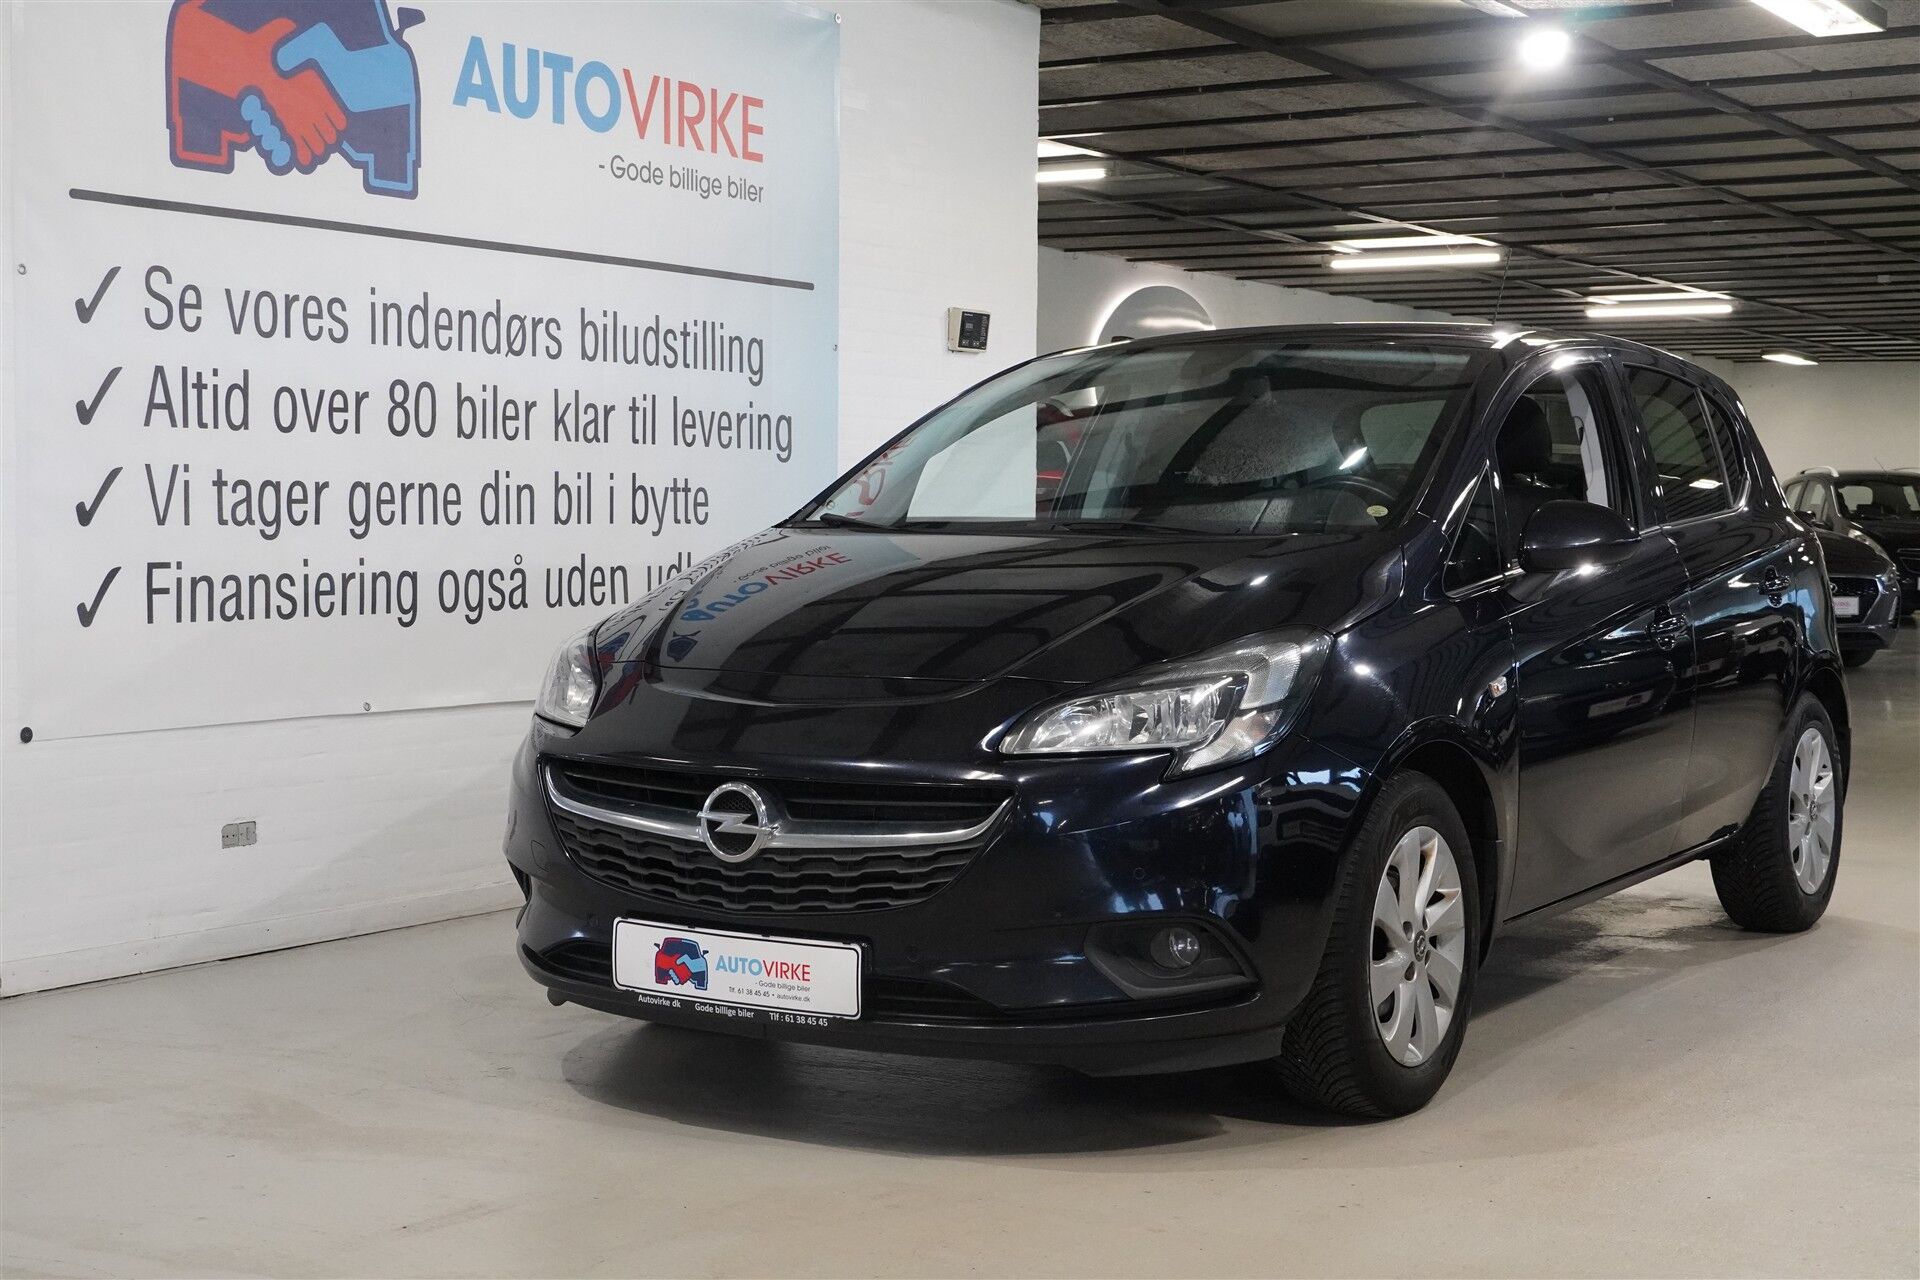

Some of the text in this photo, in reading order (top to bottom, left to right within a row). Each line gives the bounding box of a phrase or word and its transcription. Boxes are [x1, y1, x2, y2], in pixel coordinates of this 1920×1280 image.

[453, 35, 765, 165] AUTOVIRKE
[610, 154, 665, 188] Gode
[669, 165, 722, 201] billige
[727, 173, 765, 204] biler
[144, 266, 765, 388] Se vores indendørs biludstilling
[144, 365, 793, 464] Altid over 80 biler klar til levering
[144, 463, 711, 542] Vi tager gerne din bil i bytte
[146, 559, 419, 629] Finansiering
[438, 554, 529, 627] også
[545, 552, 629, 611] uden
[715, 954, 811, 982] AUTOVIRKE
[758, 980, 776, 989] Gode
[777, 982, 796, 992] billige
[796, 984, 811, 993] biler
[638, 994, 681, 1008] Autovirke dk
[694, 1003, 755, 1018] Gode billige biler
[737, 987, 744, 995] 61
[745, 988, 753, 996] 38
[754, 989, 762, 997] 45
[762, 990, 770, 998] 45
[785, 1014, 795, 1023] 61
[796, 1015, 806, 1024] 38
[807, 1017, 817, 1026] 45
[818, 1018, 828, 1027] 45
